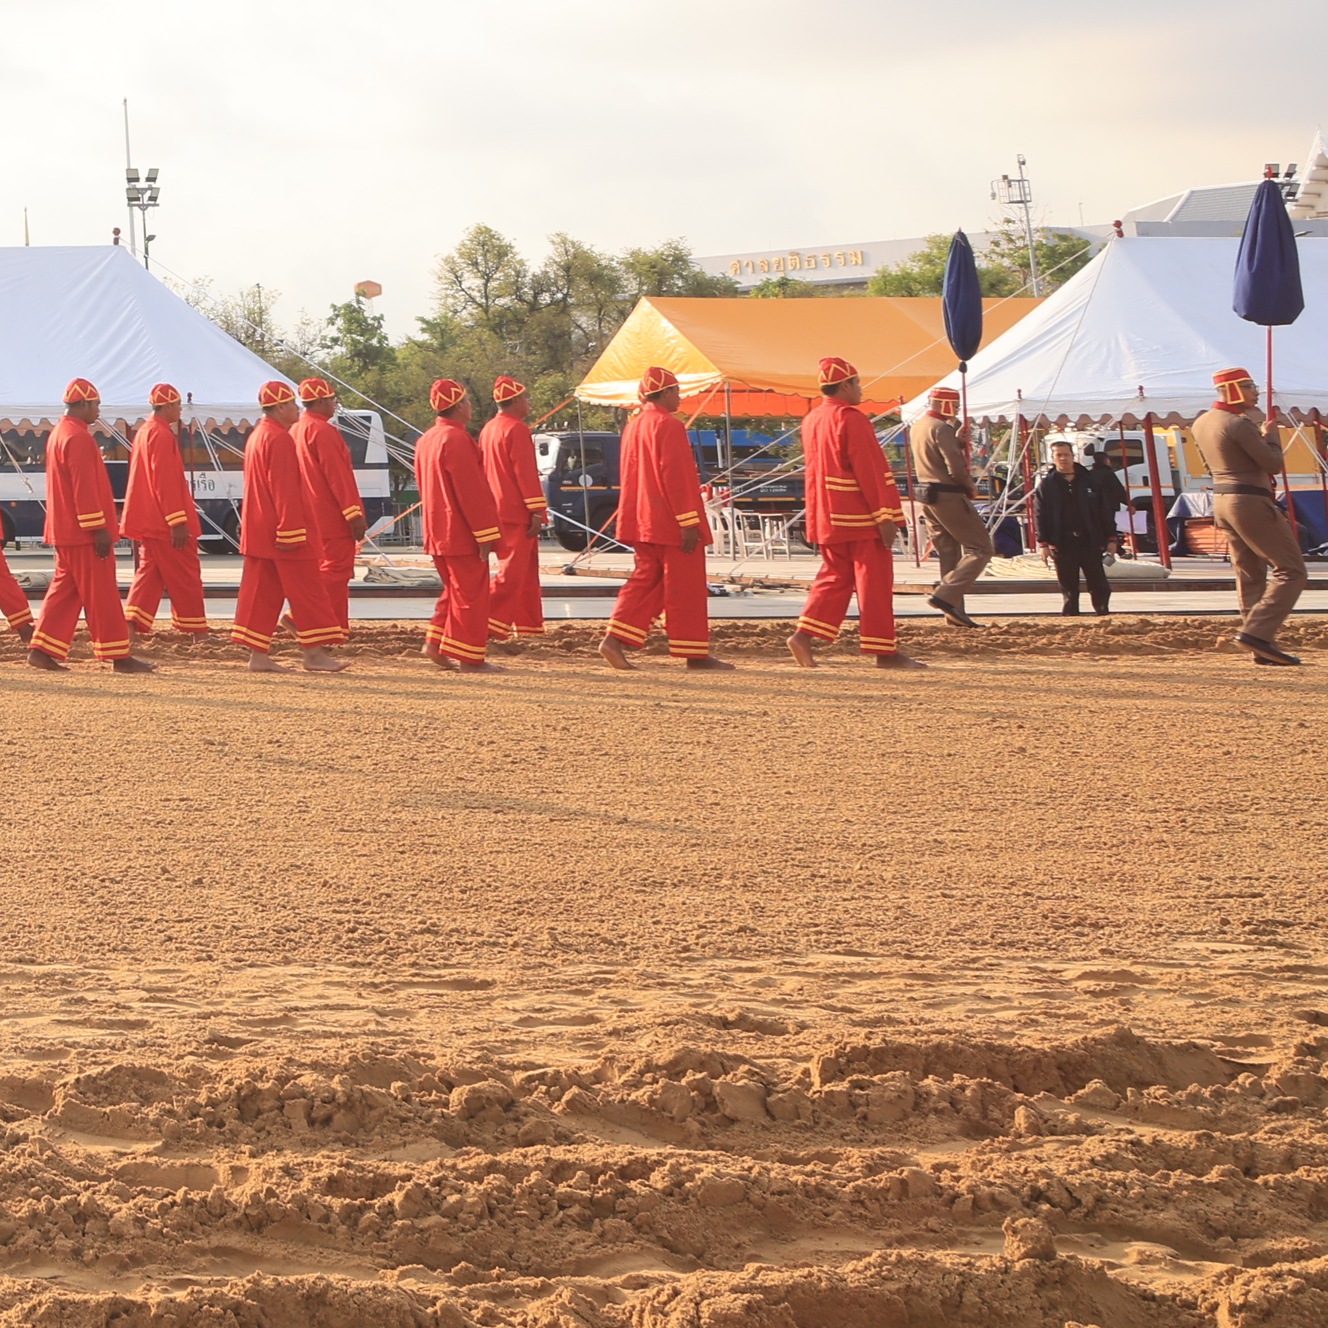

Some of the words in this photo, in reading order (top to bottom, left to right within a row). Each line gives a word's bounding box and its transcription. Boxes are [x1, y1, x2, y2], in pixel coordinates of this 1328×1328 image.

[730, 250, 864, 276] ศาลยุติธรรม
